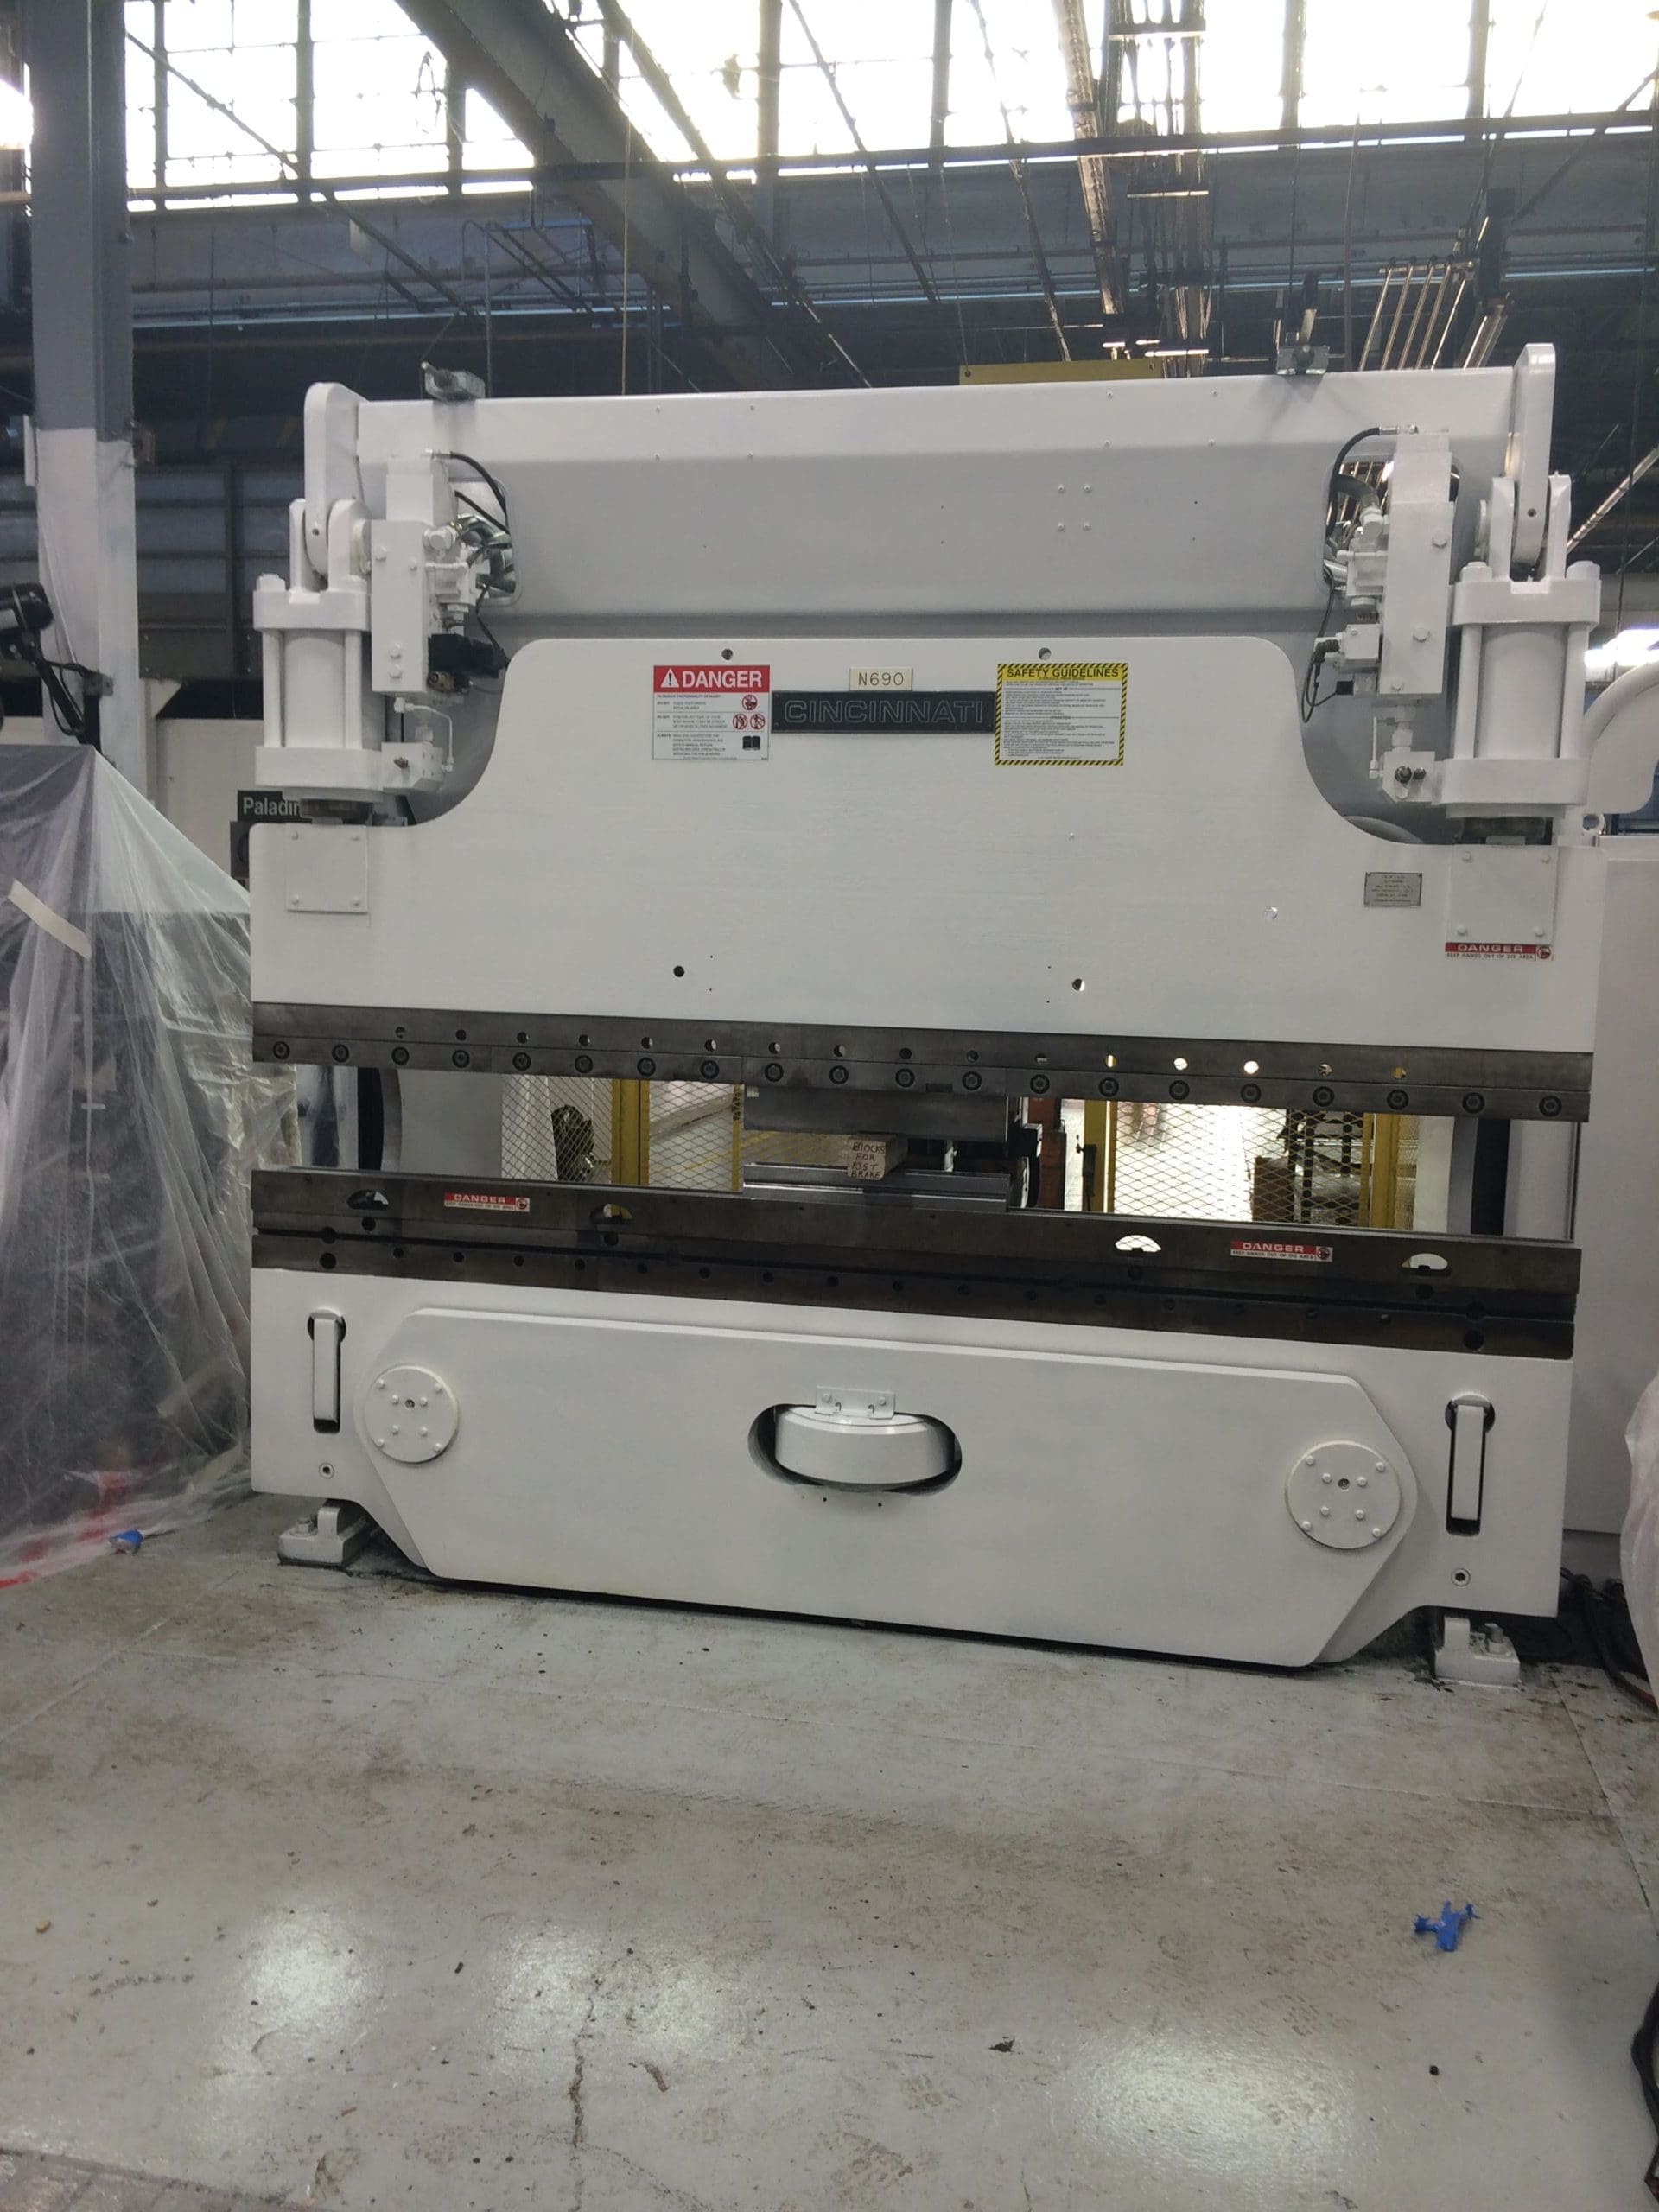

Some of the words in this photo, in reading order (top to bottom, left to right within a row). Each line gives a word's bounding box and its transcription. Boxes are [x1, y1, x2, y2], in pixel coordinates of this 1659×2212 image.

[1007, 668, 1049, 678] SAFETY
[1052, 668, 1119, 677] GUIDELINES
[682, 670, 762, 689] DANGER
[857, 672, 904, 686] N690
[784, 700, 983, 723] CINCINNATI
[1457, 944, 1523, 953] DANGER
[856, 1152, 875, 1161] FOR
[454, 1193, 505, 1204] DANGER
[1242, 1242, 1304, 1253] DANGER
